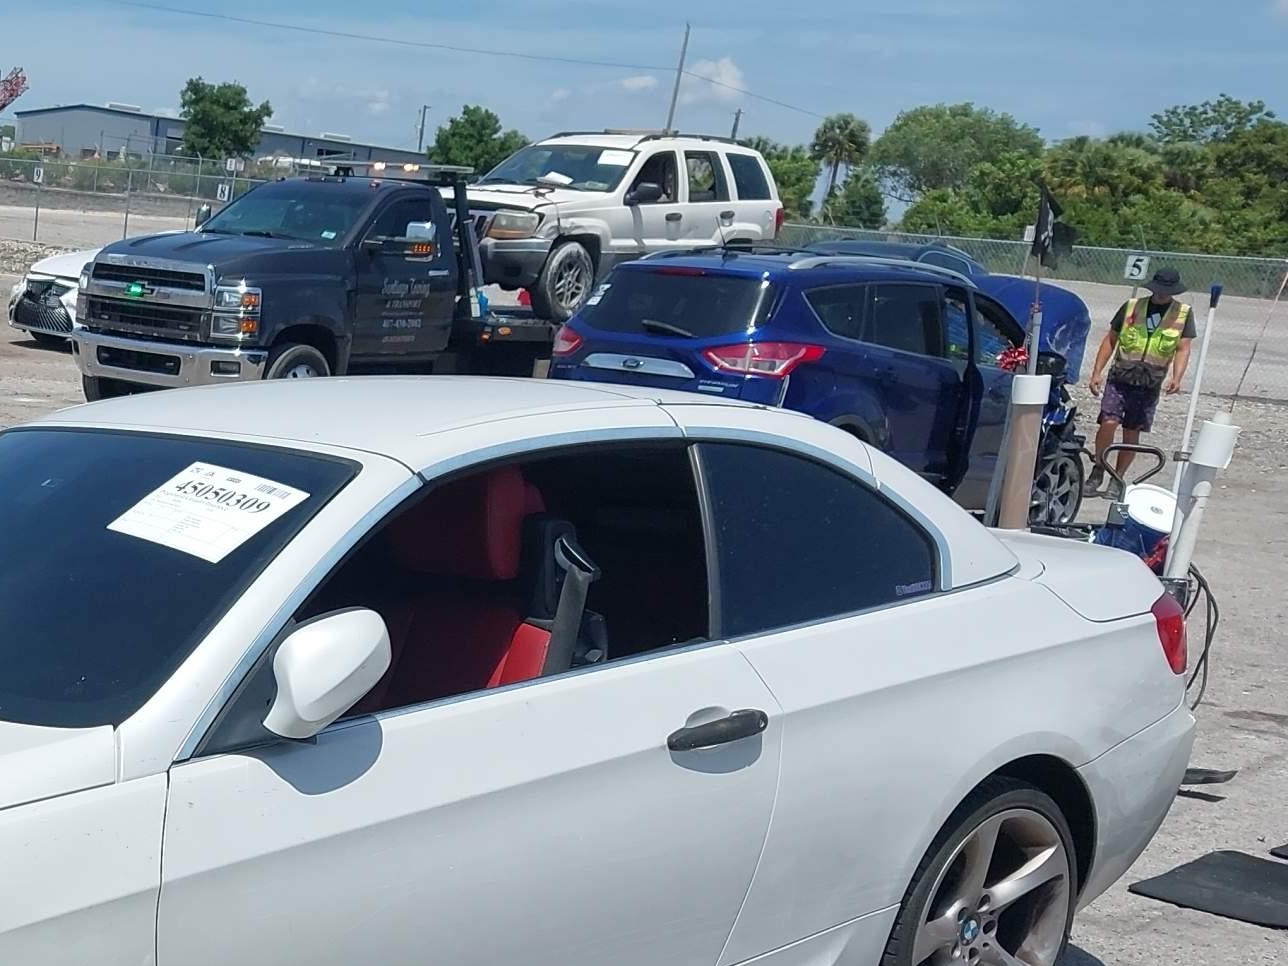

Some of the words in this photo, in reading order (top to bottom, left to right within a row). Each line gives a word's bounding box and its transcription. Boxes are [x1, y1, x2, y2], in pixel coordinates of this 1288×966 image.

[219, 184, 227, 199] 8
[1129, 258, 1144, 277] 5
[176, 480, 270, 513] 45050309
